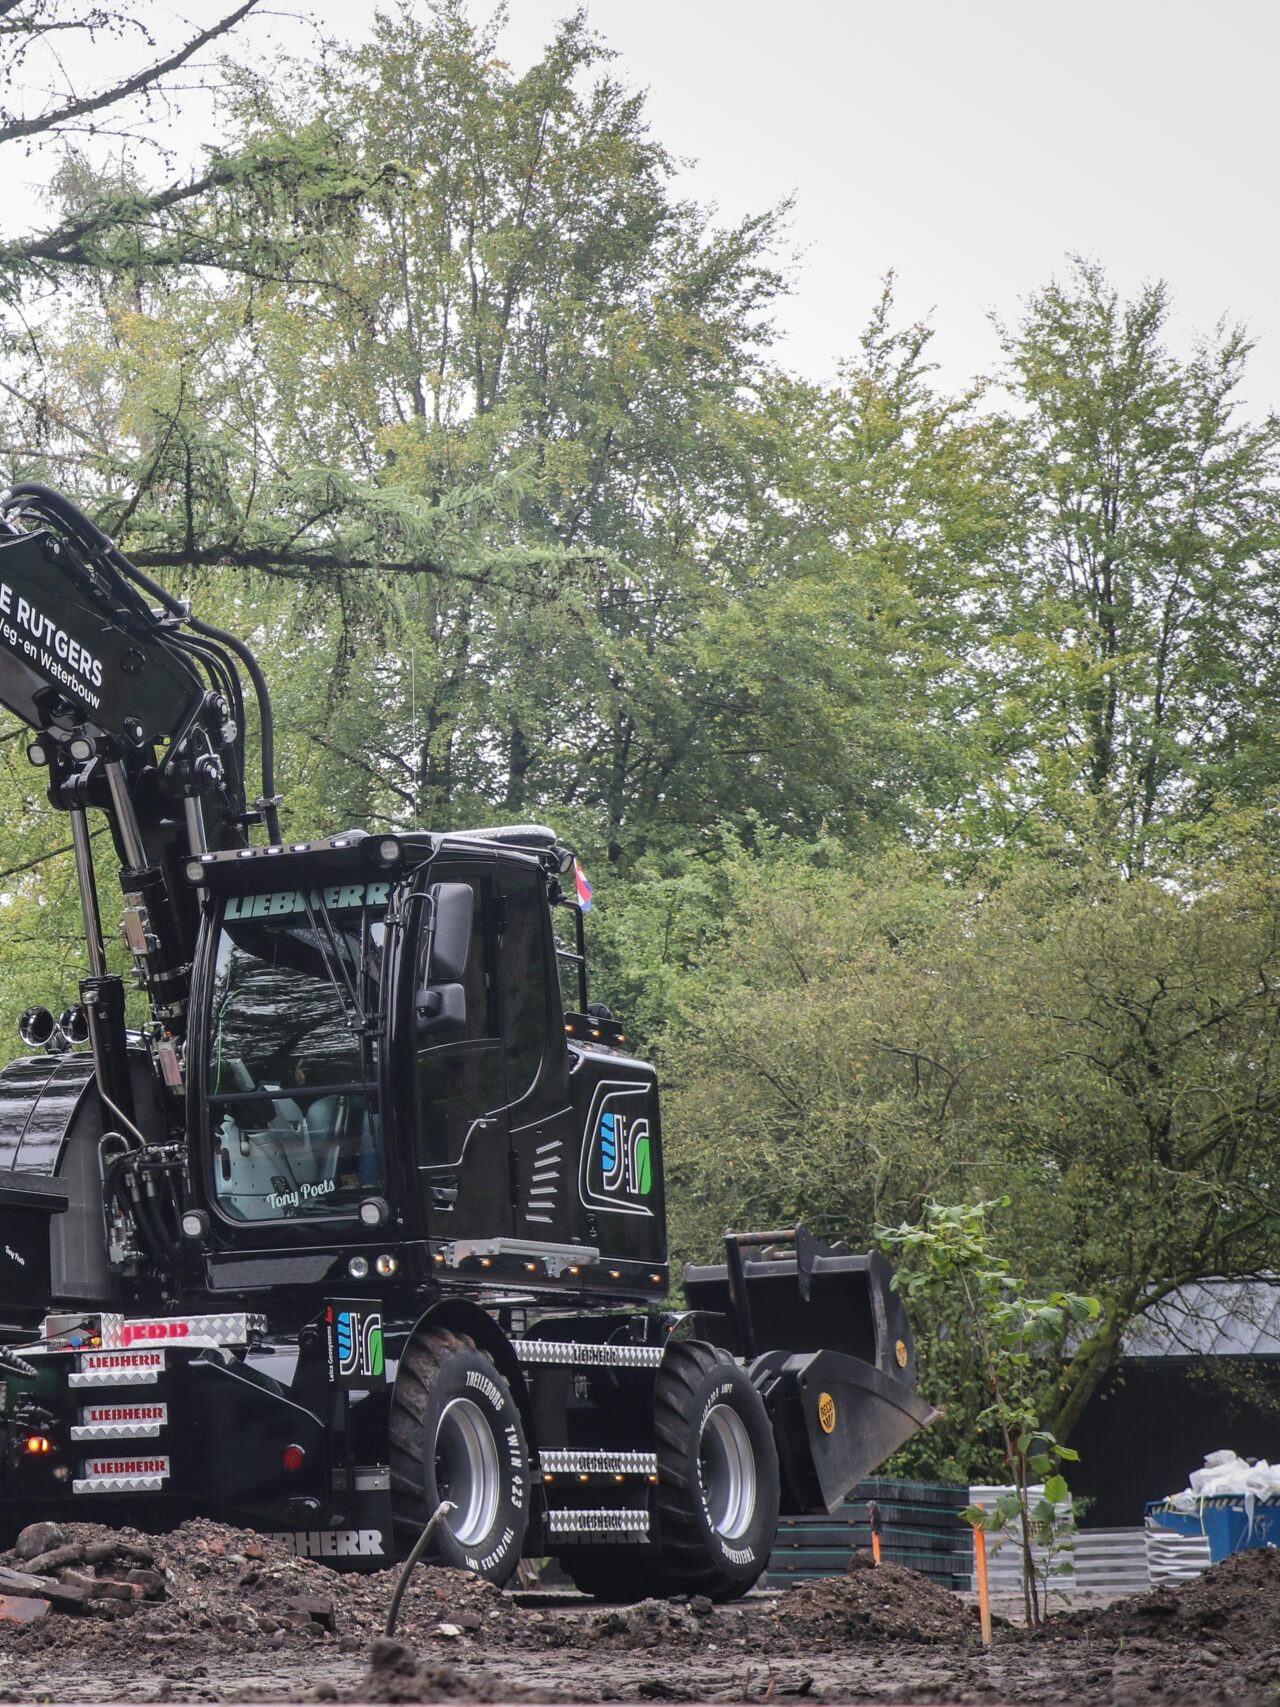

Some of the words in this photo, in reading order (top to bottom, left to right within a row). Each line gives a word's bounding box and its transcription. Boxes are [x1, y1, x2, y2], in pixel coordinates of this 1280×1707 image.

[17, 597, 103, 687] RUTGERS
[40, 649, 101, 710] Waterbouw
[267, 1191, 299, 1208] Tony
[300, 1179, 335, 1199] Poets
[89, 1354, 161, 1369] LIEBHERR
[466, 1371, 504, 1411] TRELLEBORG
[91, 1407, 164, 1422] LIEBHERR
[505, 1424, 522, 1468] TWIN
[93, 1460, 166, 1475] LIEBHERR
[511, 1475, 523, 1509] 423
